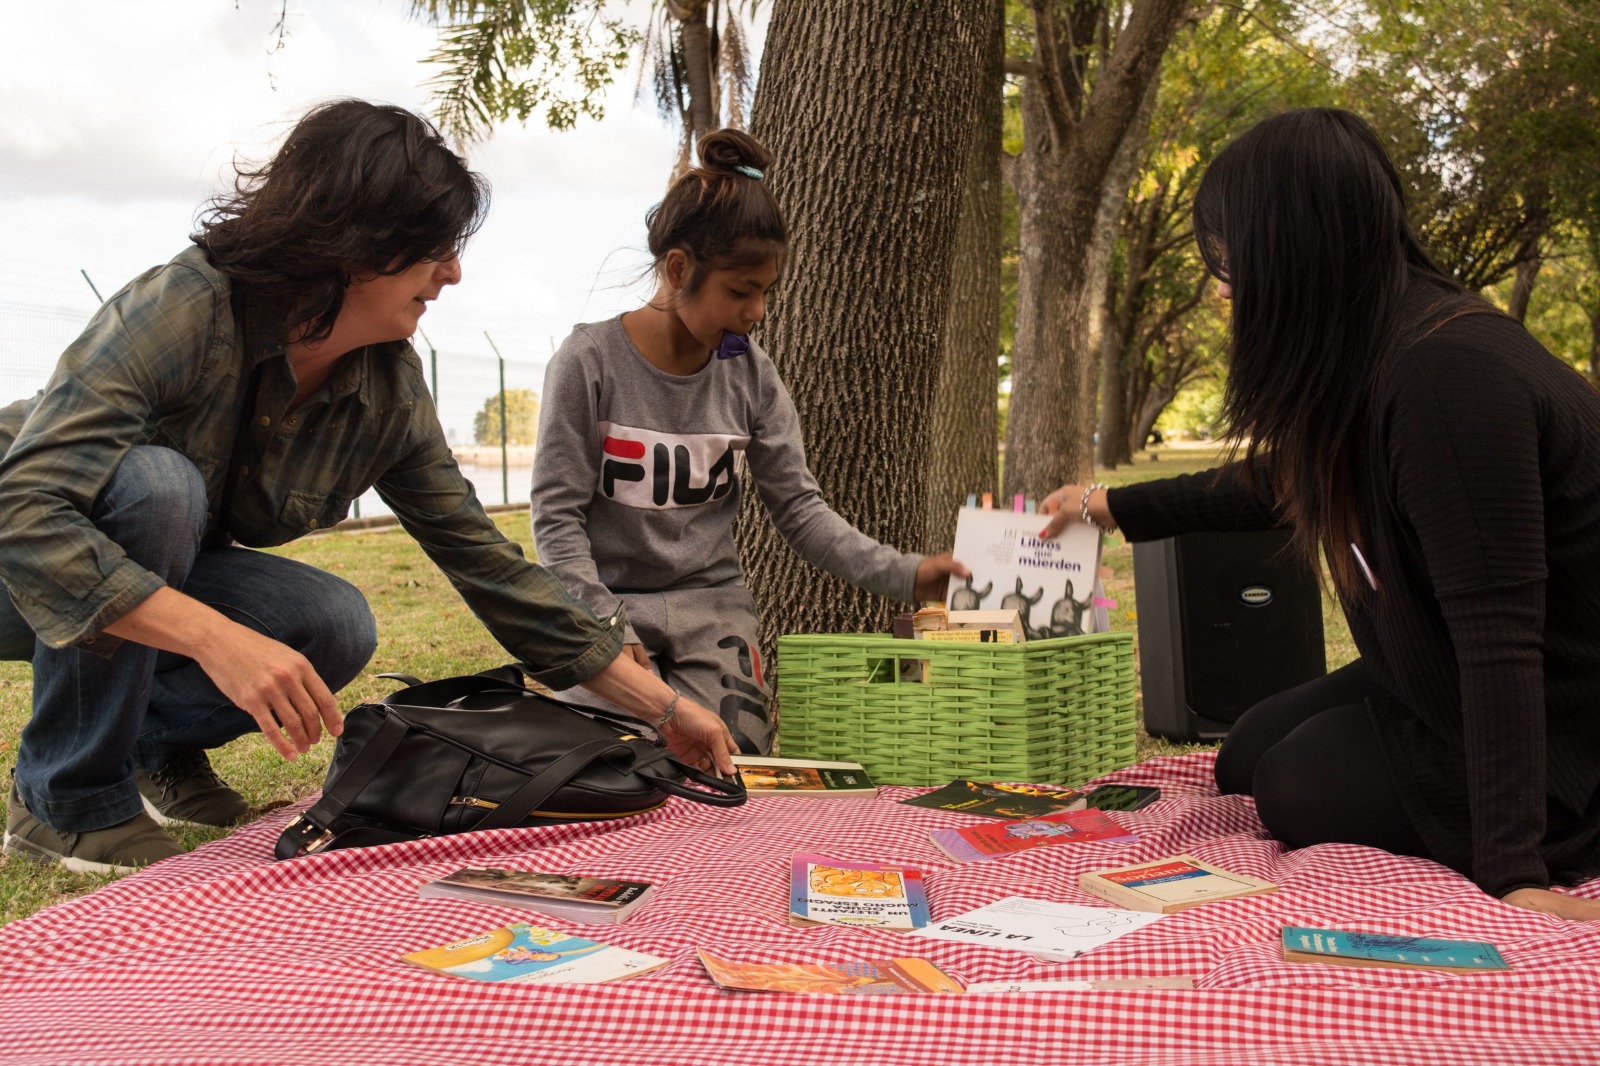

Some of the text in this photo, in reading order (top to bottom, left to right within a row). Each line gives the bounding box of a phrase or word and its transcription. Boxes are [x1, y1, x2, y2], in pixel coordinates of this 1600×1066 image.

[603, 436, 734, 506] FILA
[1021, 537, 1062, 552] Libros
[1034, 550, 1053, 560] que
[1018, 555, 1081, 572] muerden
[1110, 866, 1192, 883] Soriano
[797, 897, 859, 906] ESPACIO
[810, 907, 880, 915] ELEFANTE
[939, 924, 1034, 941] LA LÍNEA
